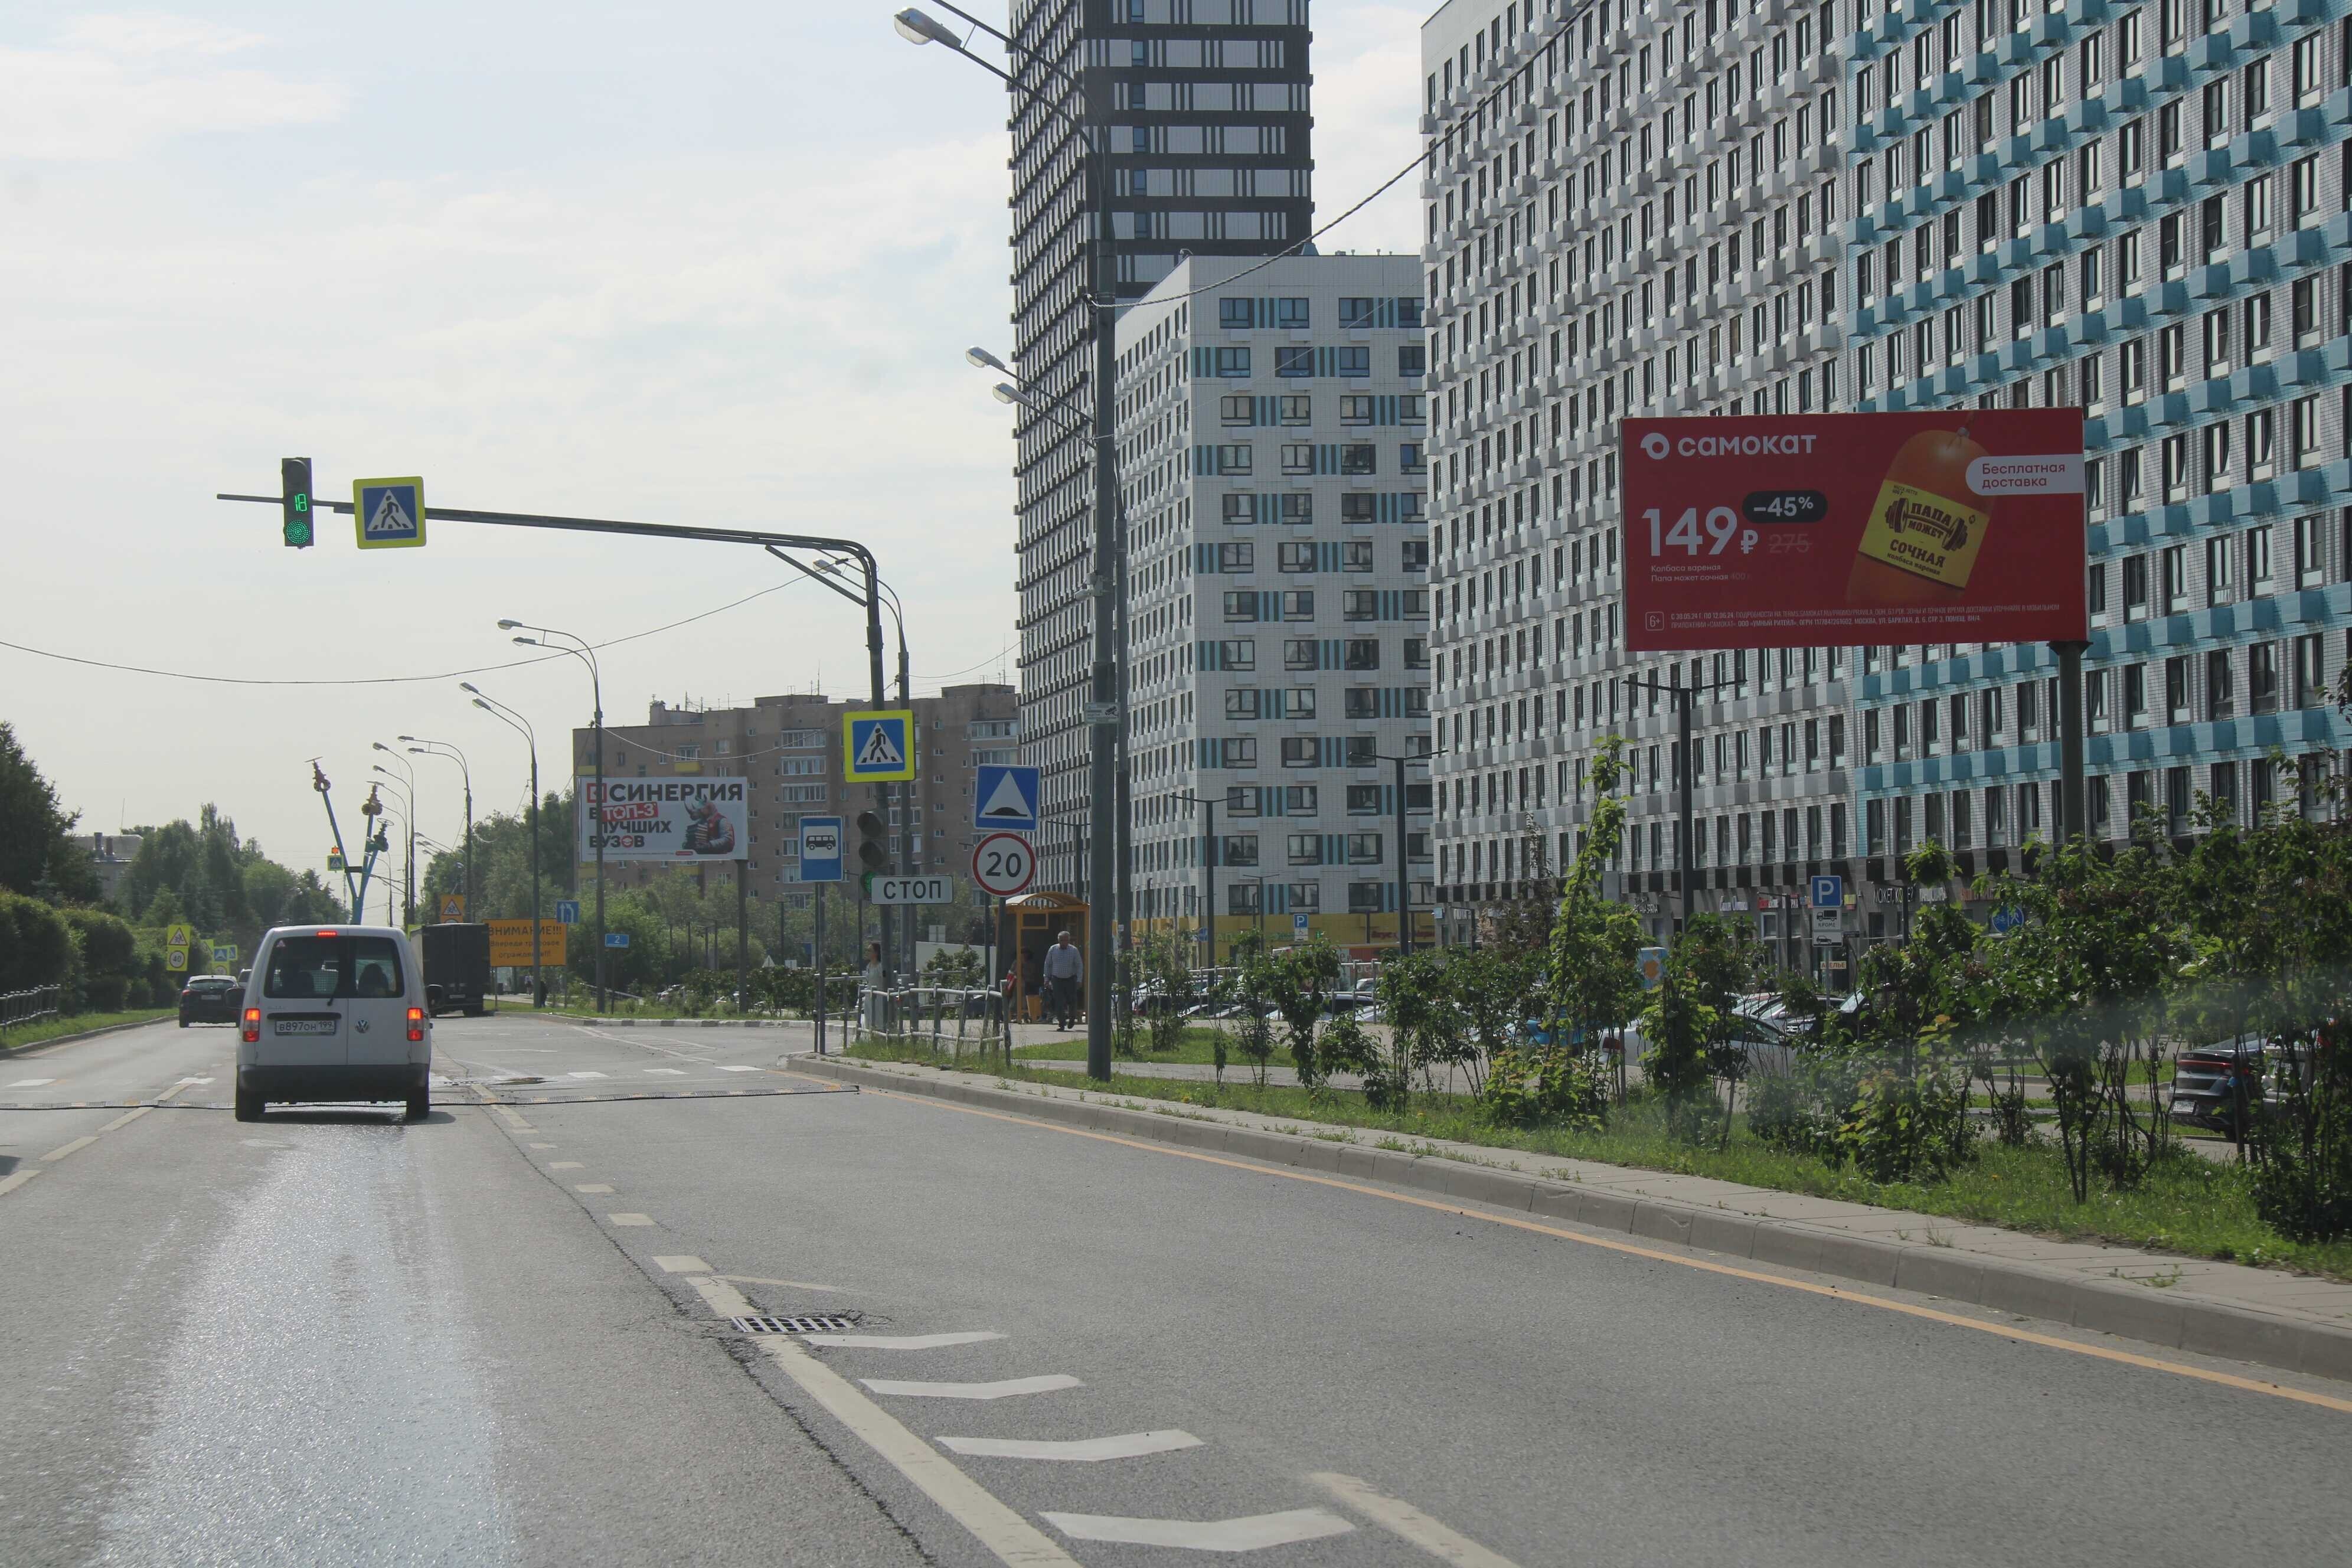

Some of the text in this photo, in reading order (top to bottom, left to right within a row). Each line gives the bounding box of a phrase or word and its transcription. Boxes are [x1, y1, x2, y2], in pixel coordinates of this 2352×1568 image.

[1677, 435, 1817, 456] самокат
[1982, 463, 2065, 474] Бесплатная
[1982, 477, 2047, 489] доставка
[295, 494, 308, 512] 18
[1910, 502, 1952, 527] ПАПА
[1907, 520, 1944, 539] МОЖЕТ
[1890, 539, 1946, 568] СОЧНАЯ
[1687, 565, 1721, 573] вареная
[1649, 615, 1661, 628] 6+
[609, 783, 743, 802] СИНЕРГИЯ
[985, 851, 1022, 878] 20
[883, 880, 942, 900] СТОП
[614, 936, 620, 944] 2
